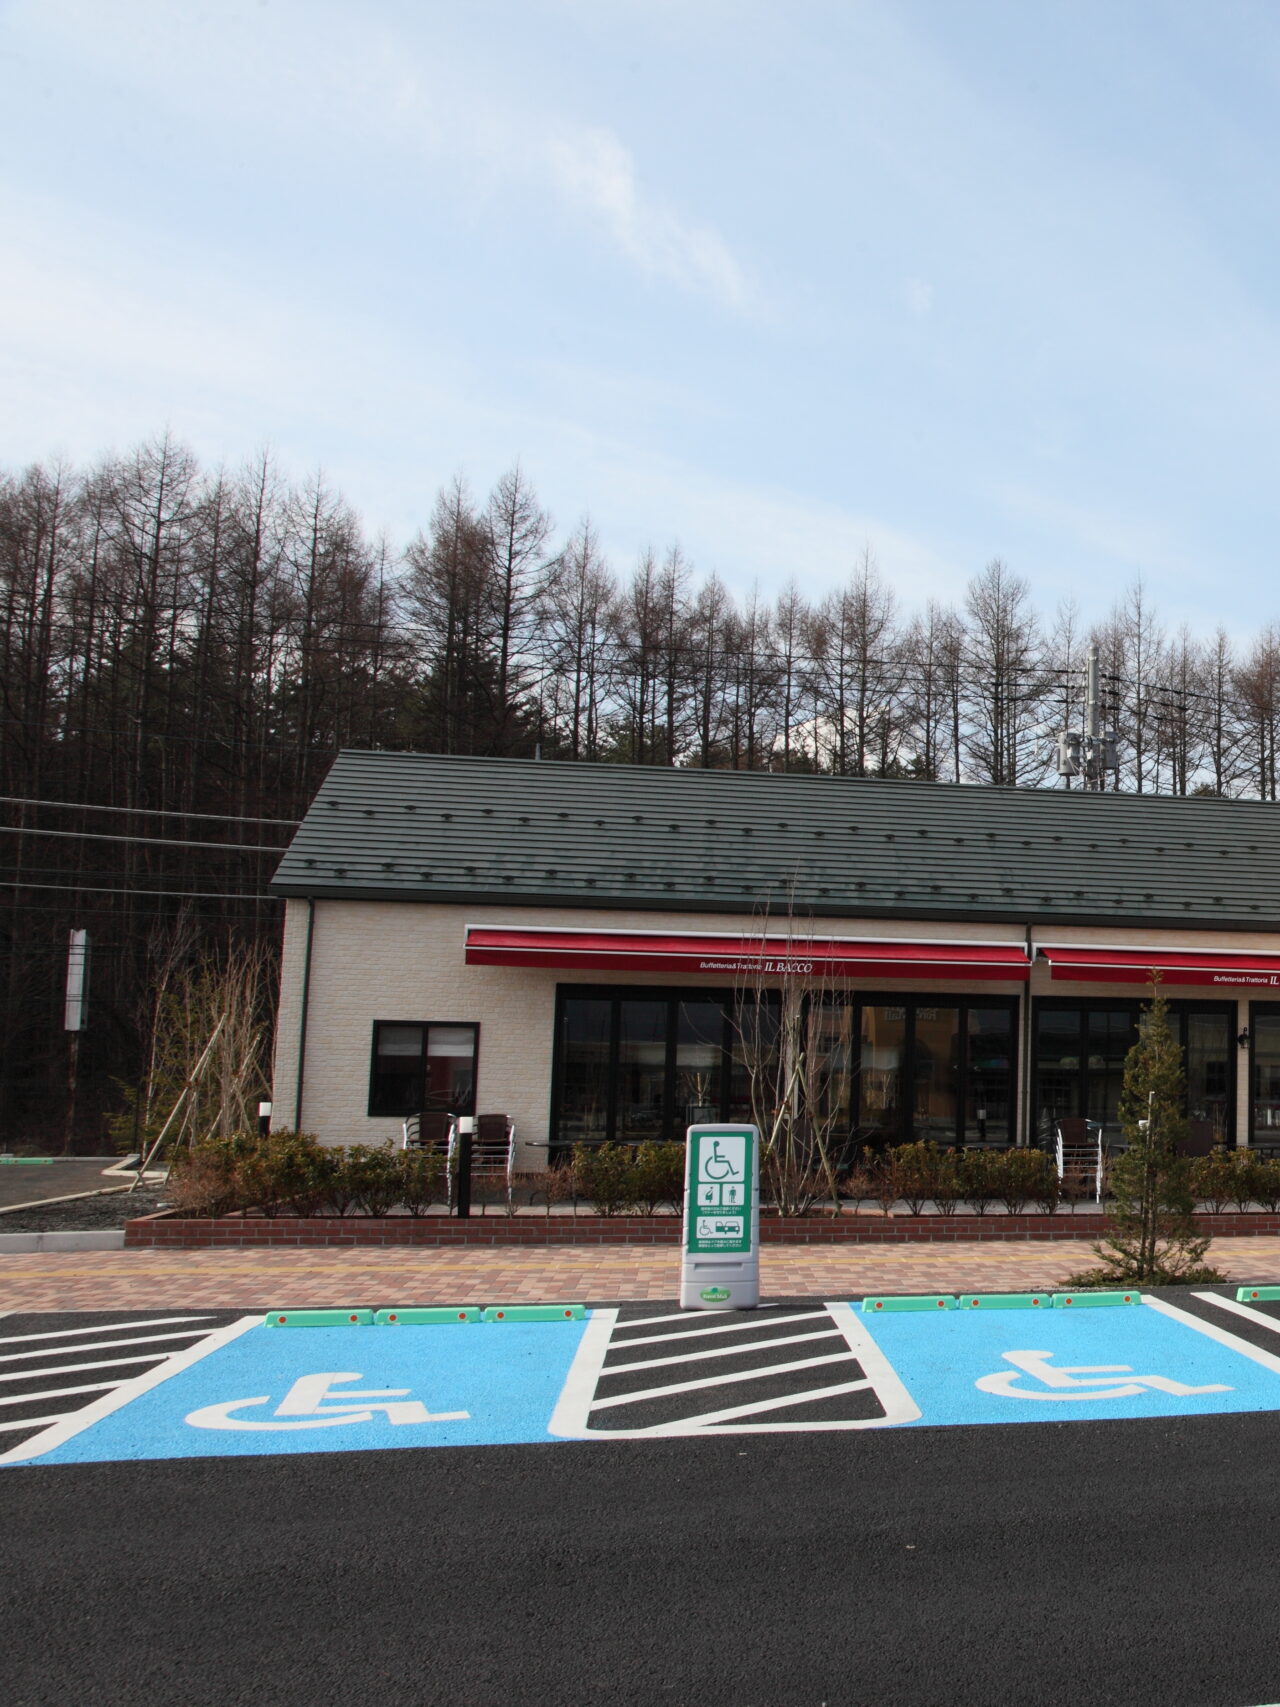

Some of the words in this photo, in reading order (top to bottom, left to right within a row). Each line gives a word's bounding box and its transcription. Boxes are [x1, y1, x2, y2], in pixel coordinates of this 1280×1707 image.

[764, 962, 775, 972] IL
[776, 963, 812, 973] BACCO
[1270, 976, 1280, 985] IL
